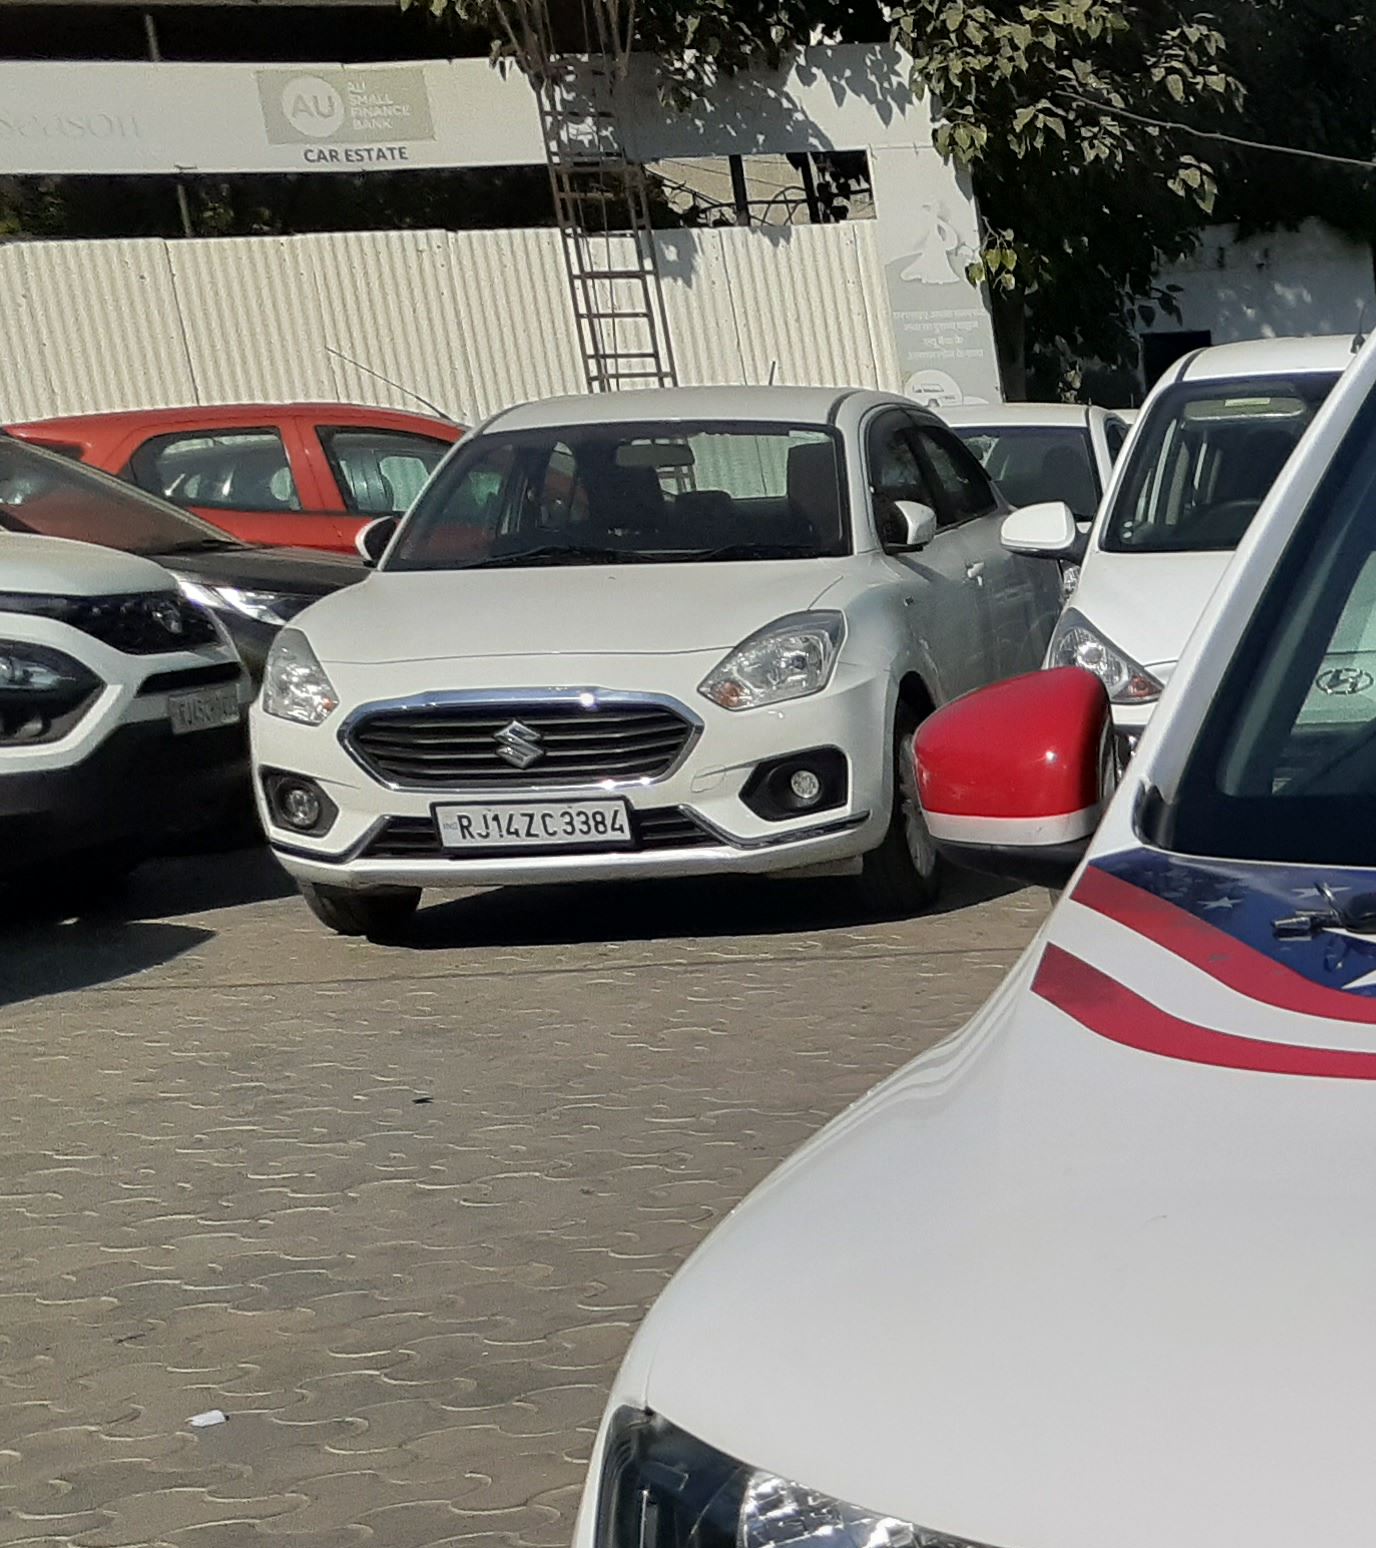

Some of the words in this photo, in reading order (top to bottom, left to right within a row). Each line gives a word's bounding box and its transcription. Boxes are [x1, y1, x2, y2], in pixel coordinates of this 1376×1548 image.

[291, 95, 336, 119] AU
[349, 93, 394, 106] SMALL
[351, 105, 411, 118] FINANCE
[353, 119, 393, 130] BANK
[303, 148, 341, 163] CAR
[344, 146, 409, 162] ESTATE
[457, 809, 626, 840] RJ14ZC3384
